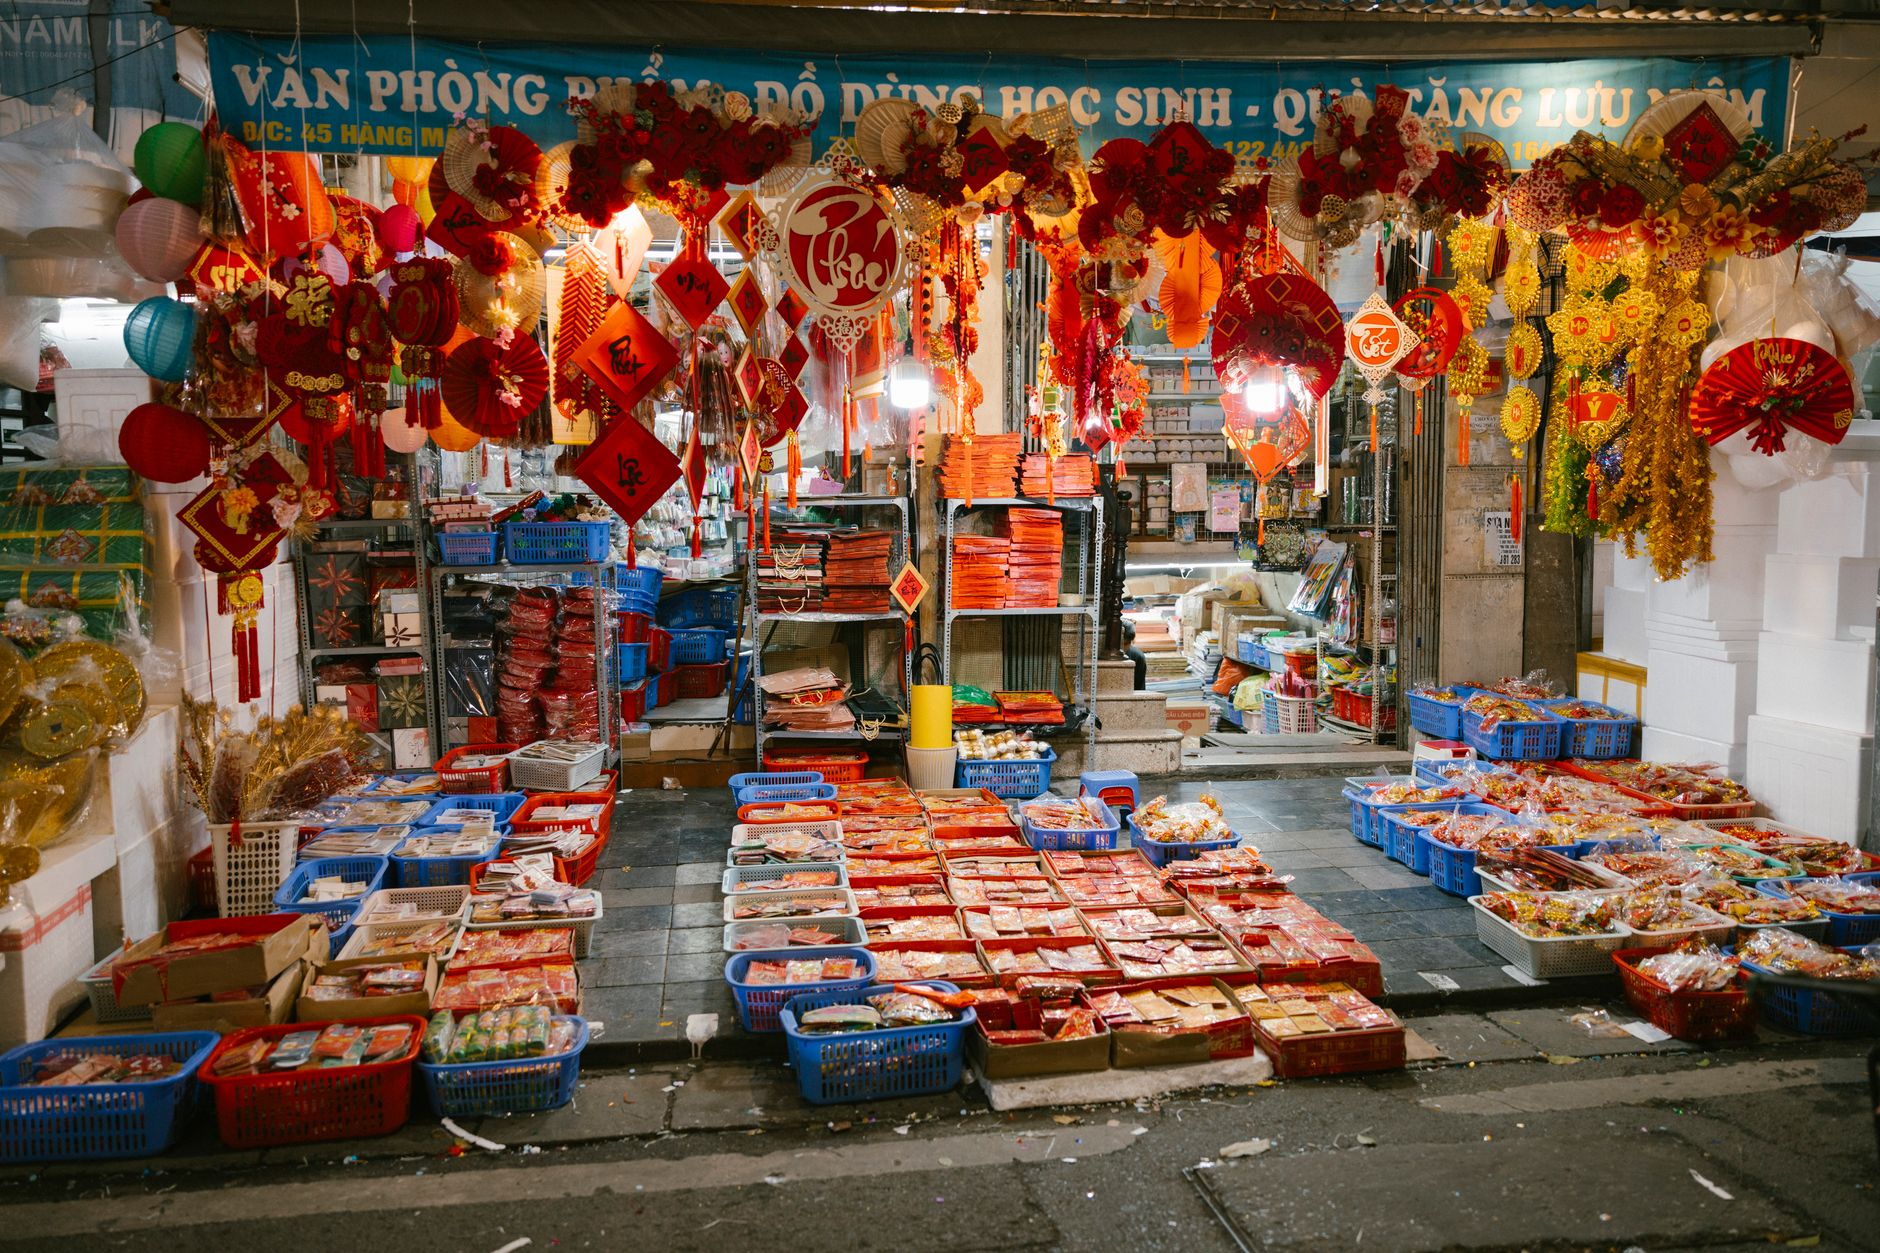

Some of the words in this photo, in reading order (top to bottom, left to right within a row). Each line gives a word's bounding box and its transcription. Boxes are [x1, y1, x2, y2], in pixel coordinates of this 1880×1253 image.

[232, 53, 350, 111] VĂN
[366, 59, 549, 116] PHÒNG
[754, 62, 825, 122] ĐỒ
[1115, 87, 1232, 127] SINH
[1536, 80, 1634, 128] LƯU
[243, 121, 292, 143] Đ/C:
[301, 123, 332, 144] 45
[341, 121, 413, 147] HÀNG
[1586, 395, 1602, 418] Ý
